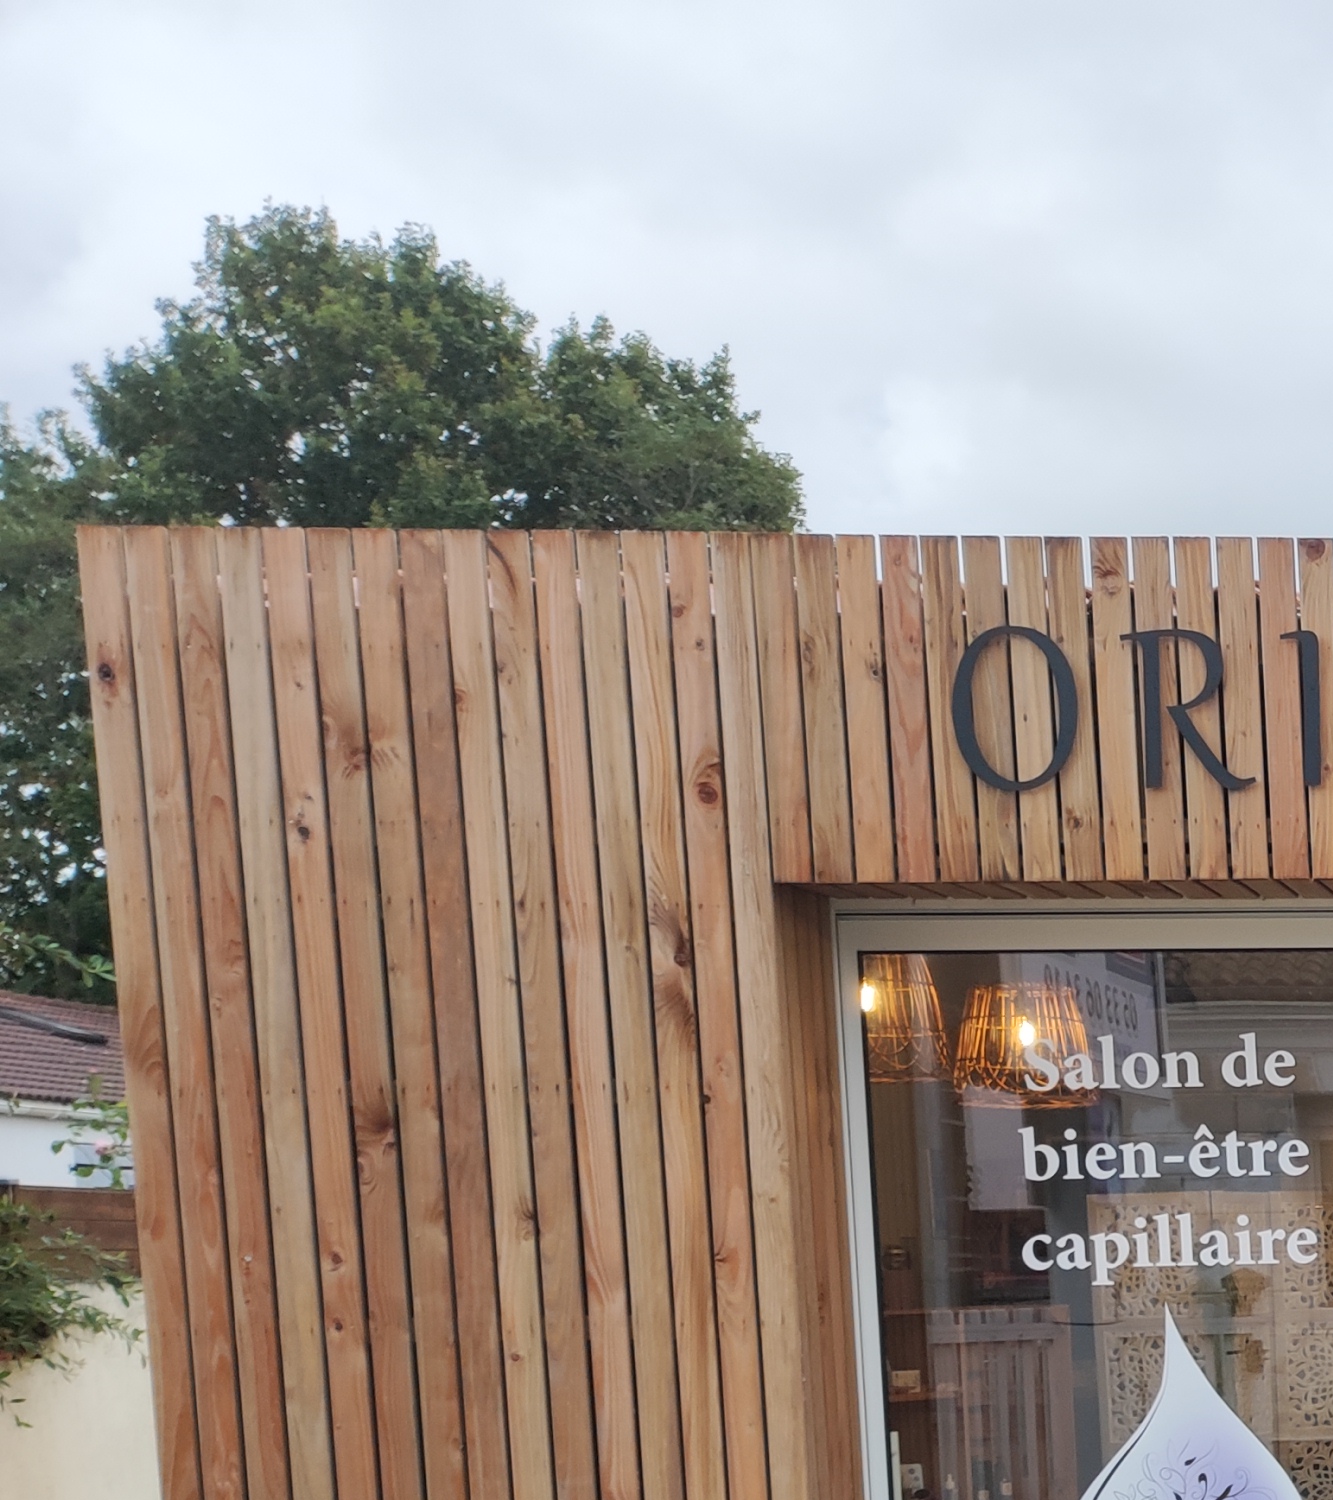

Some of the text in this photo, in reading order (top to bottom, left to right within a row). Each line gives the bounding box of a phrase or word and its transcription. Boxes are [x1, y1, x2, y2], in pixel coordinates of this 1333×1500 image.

[1022, 1031, 1297, 1092] Salon de
[1017, 1123, 1310, 1182] bien-être
[1021, 1212, 1319, 1286] capillaire
